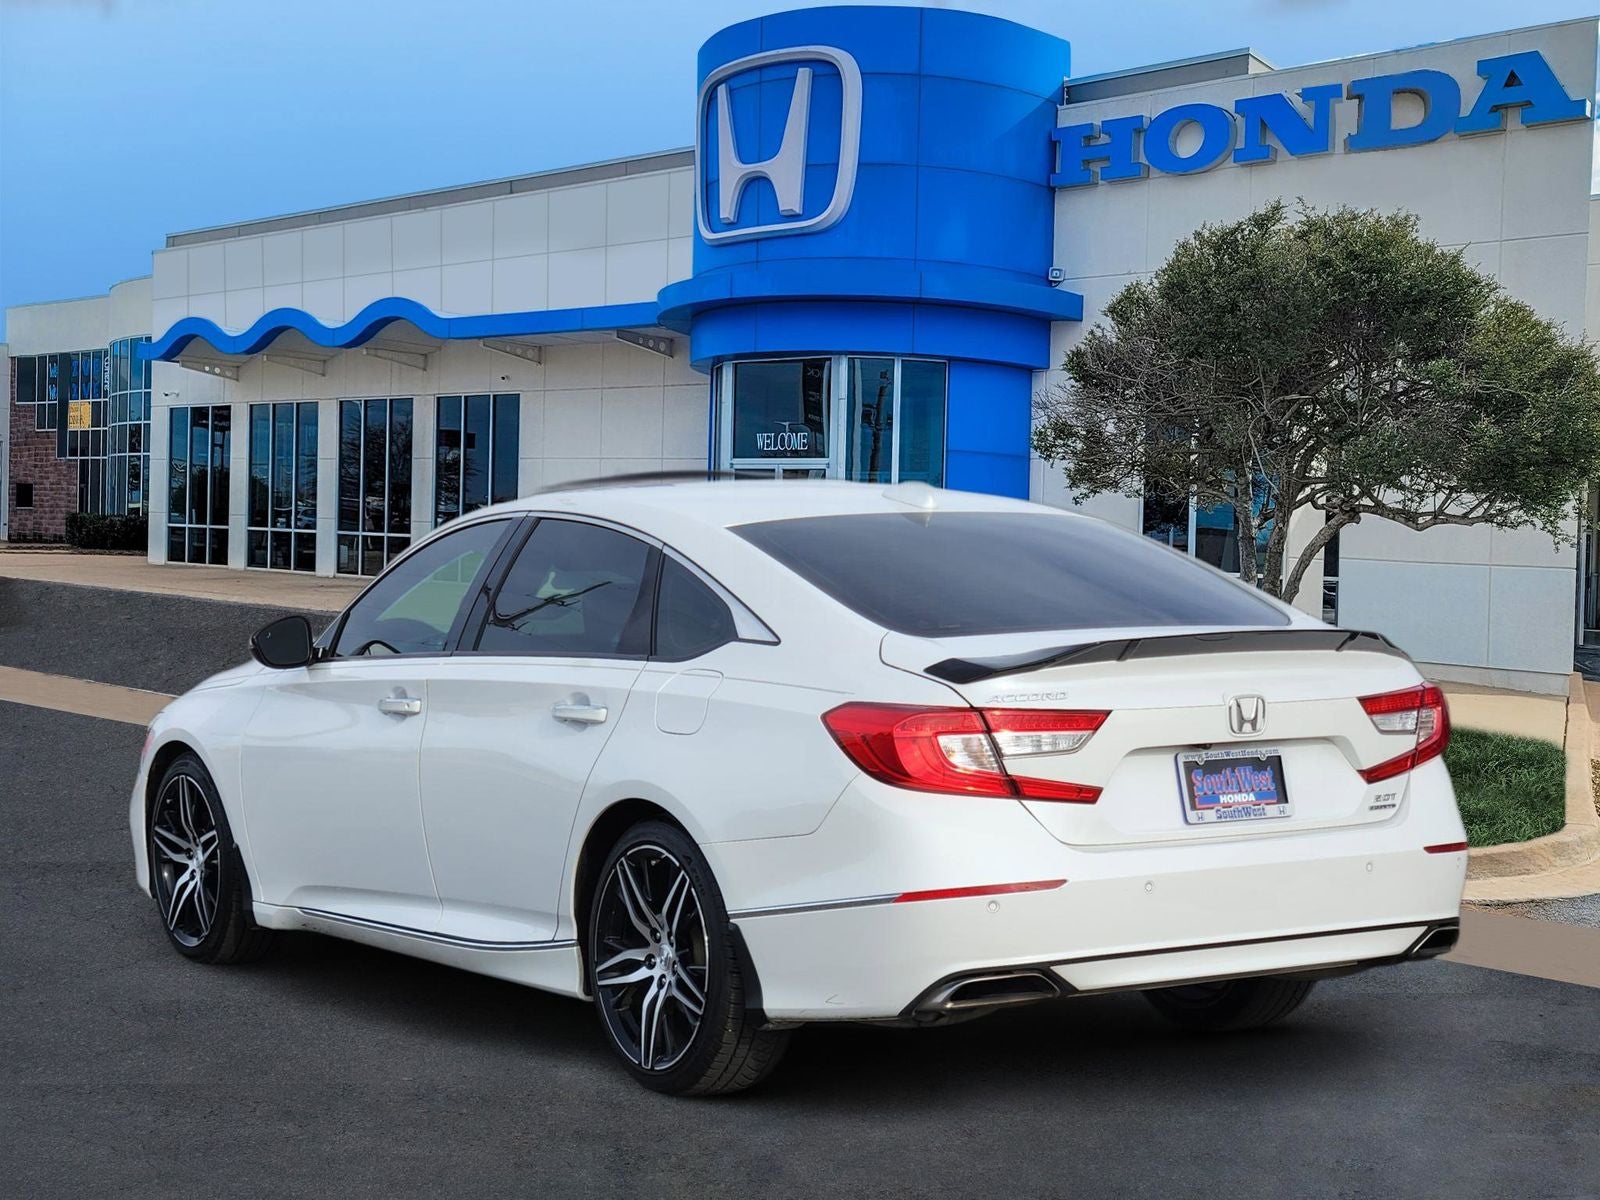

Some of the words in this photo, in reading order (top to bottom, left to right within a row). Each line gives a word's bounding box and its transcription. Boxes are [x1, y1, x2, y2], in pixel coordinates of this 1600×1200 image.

[1050, 49, 1592, 188] HONDA
[756, 432, 808, 450] WELCOME
[985, 692, 1068, 703] ACCORD
[1192, 766, 1276, 795] SouthWest
[1219, 793, 1257, 804] HONDA
[1215, 806, 1267, 821] SouthWest
